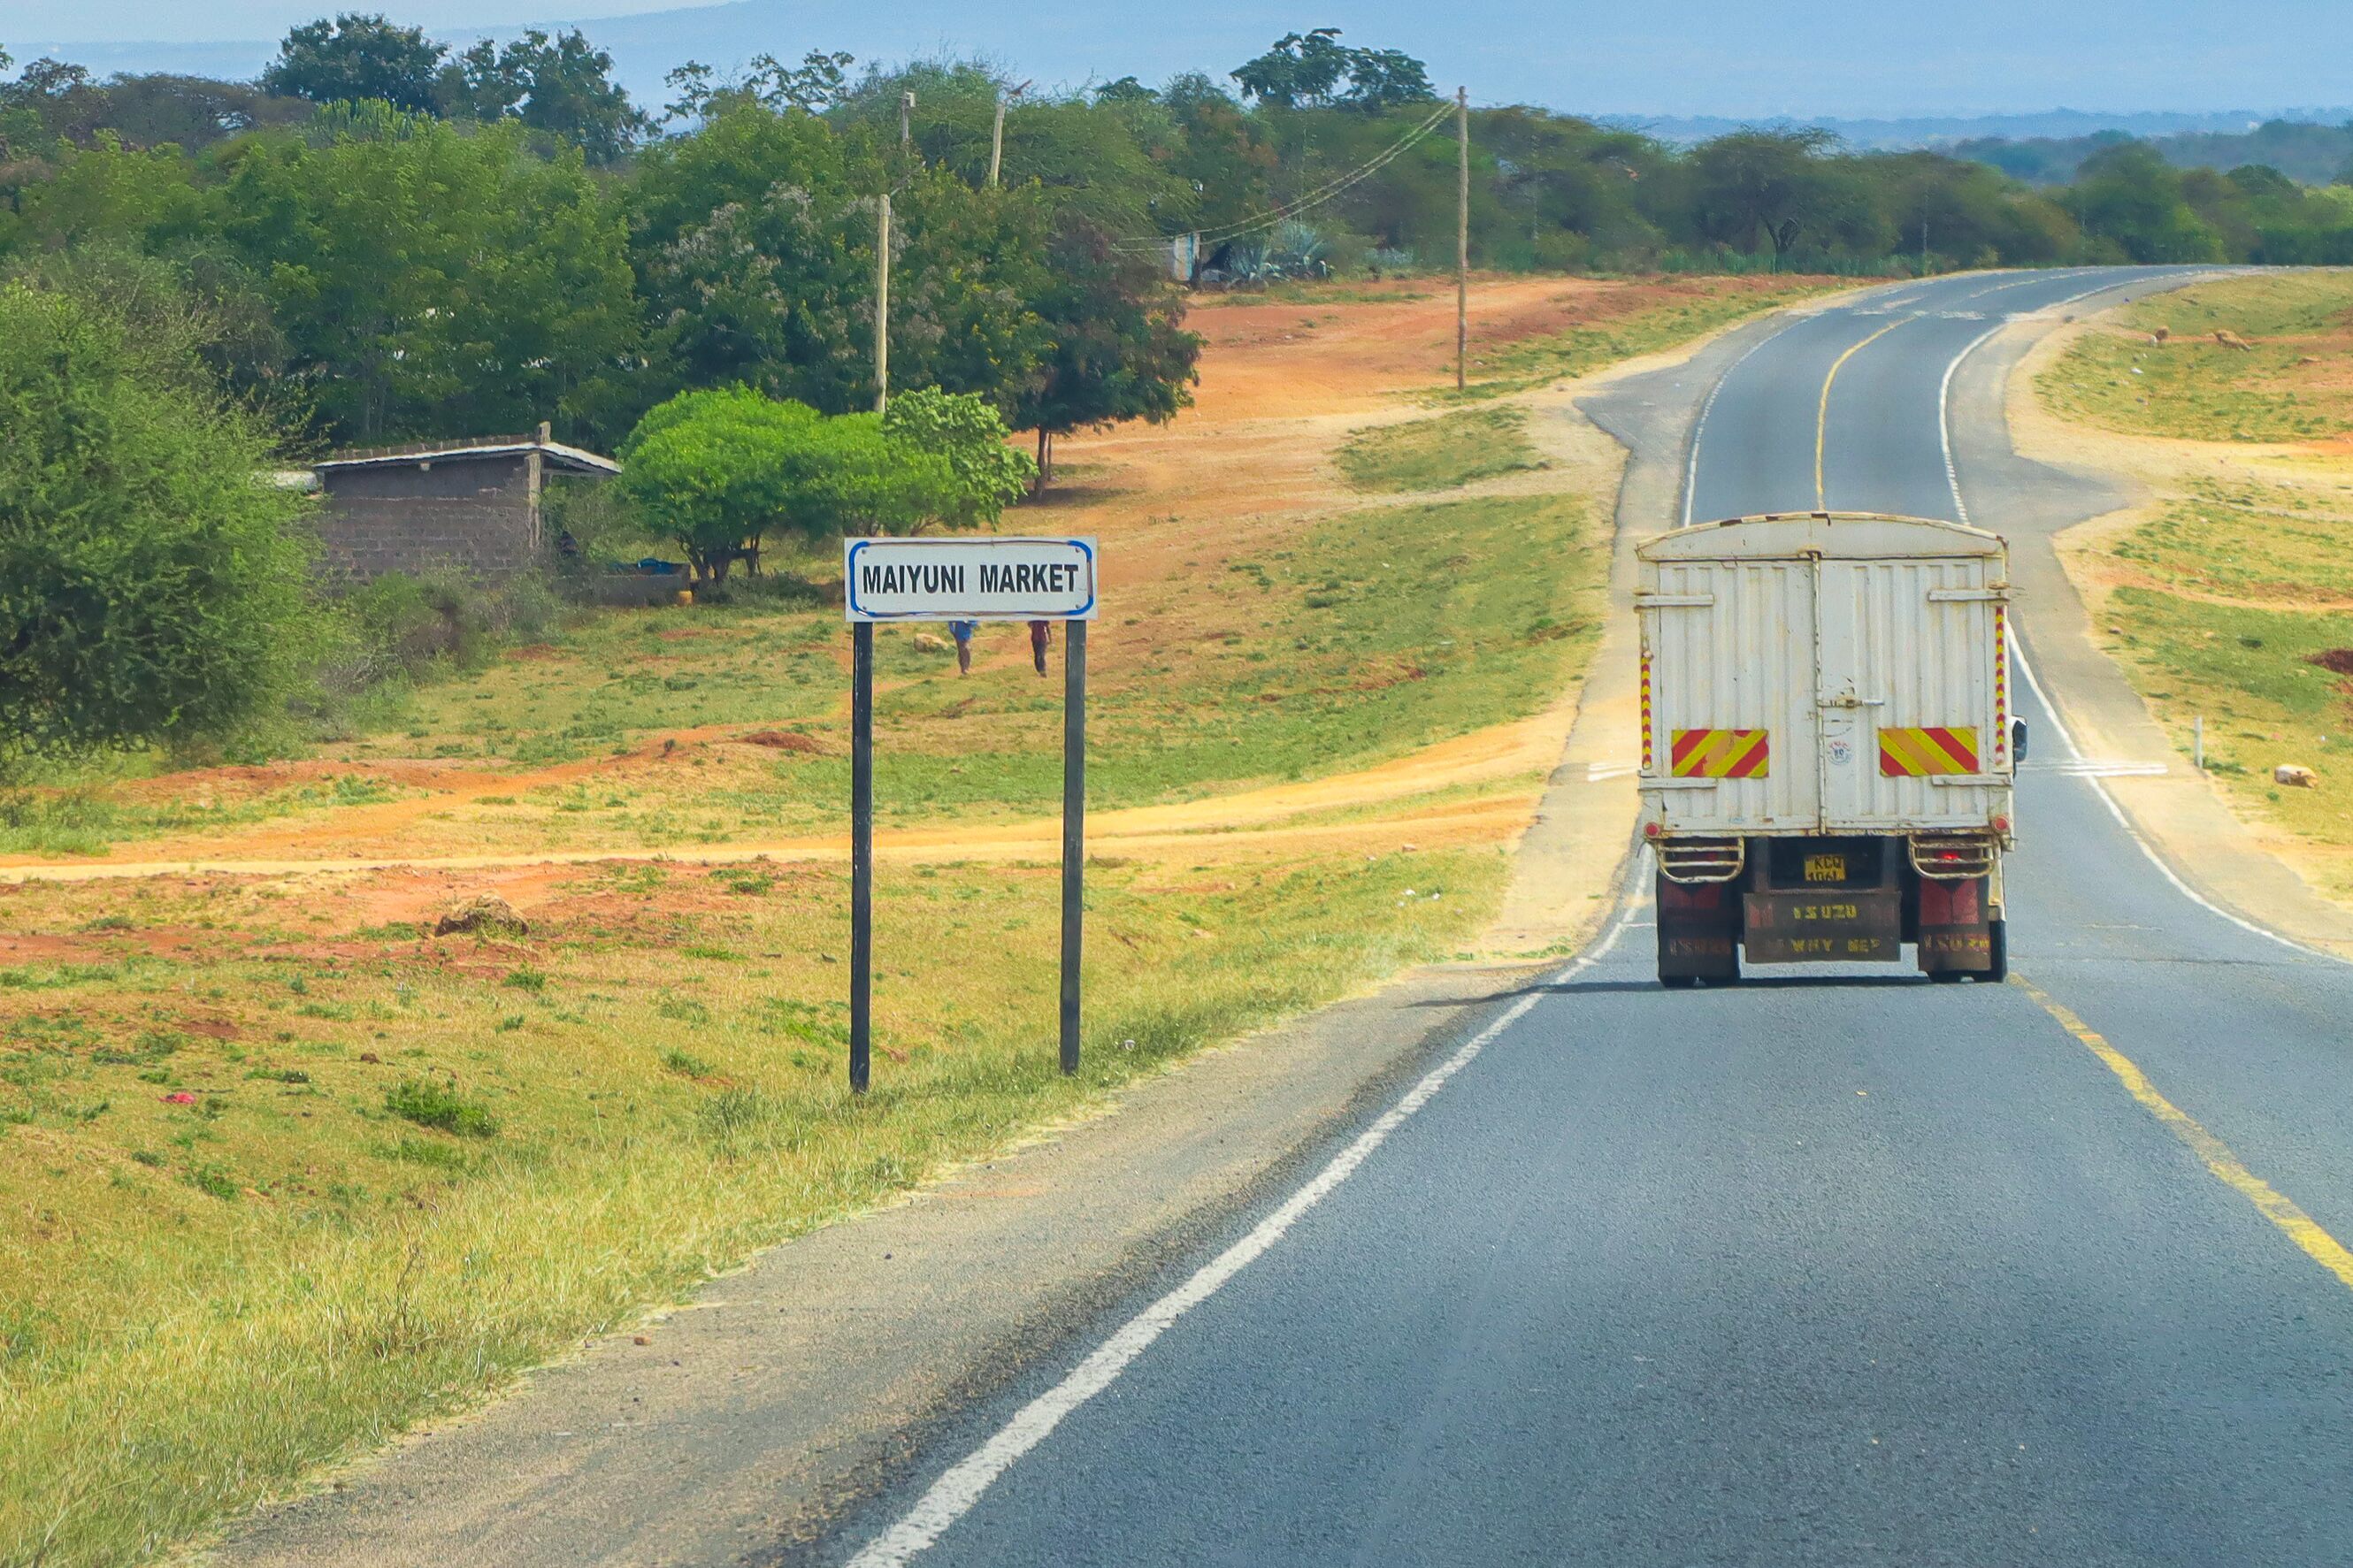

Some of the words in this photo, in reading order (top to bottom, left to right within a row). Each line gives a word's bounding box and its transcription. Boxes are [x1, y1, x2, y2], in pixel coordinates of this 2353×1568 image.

[862, 565, 964, 594] MAIYUNI
[979, 564, 1078, 593] MARKET
[1793, 905, 1857, 920] ISUZU
[1791, 938, 1833, 952] WHY
